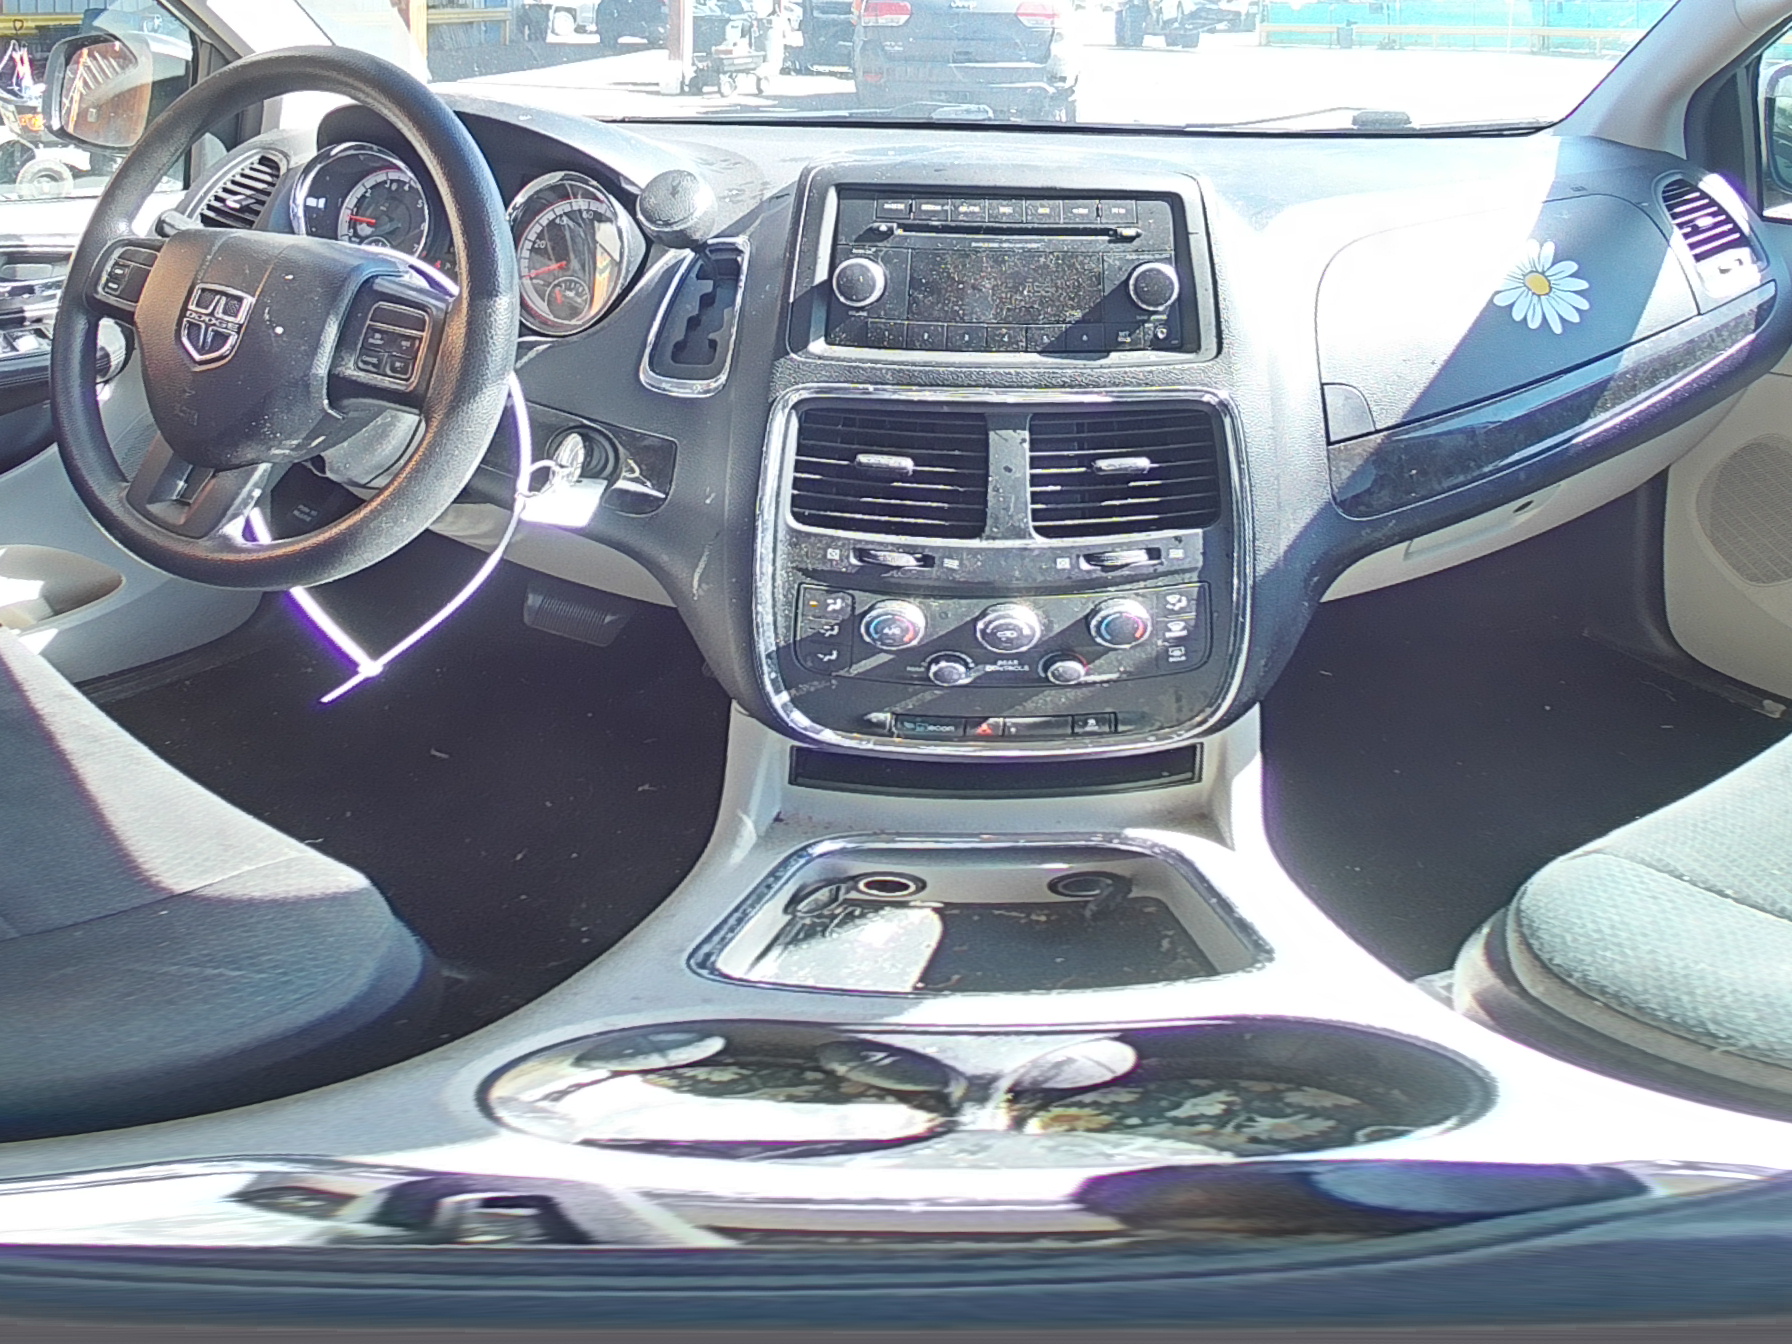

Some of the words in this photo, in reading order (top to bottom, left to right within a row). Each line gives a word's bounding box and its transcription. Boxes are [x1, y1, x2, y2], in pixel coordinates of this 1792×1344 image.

[581, 210, 595, 219] 60
[534, 239, 547, 249] 20
[186, 310, 239, 332] DODGE
